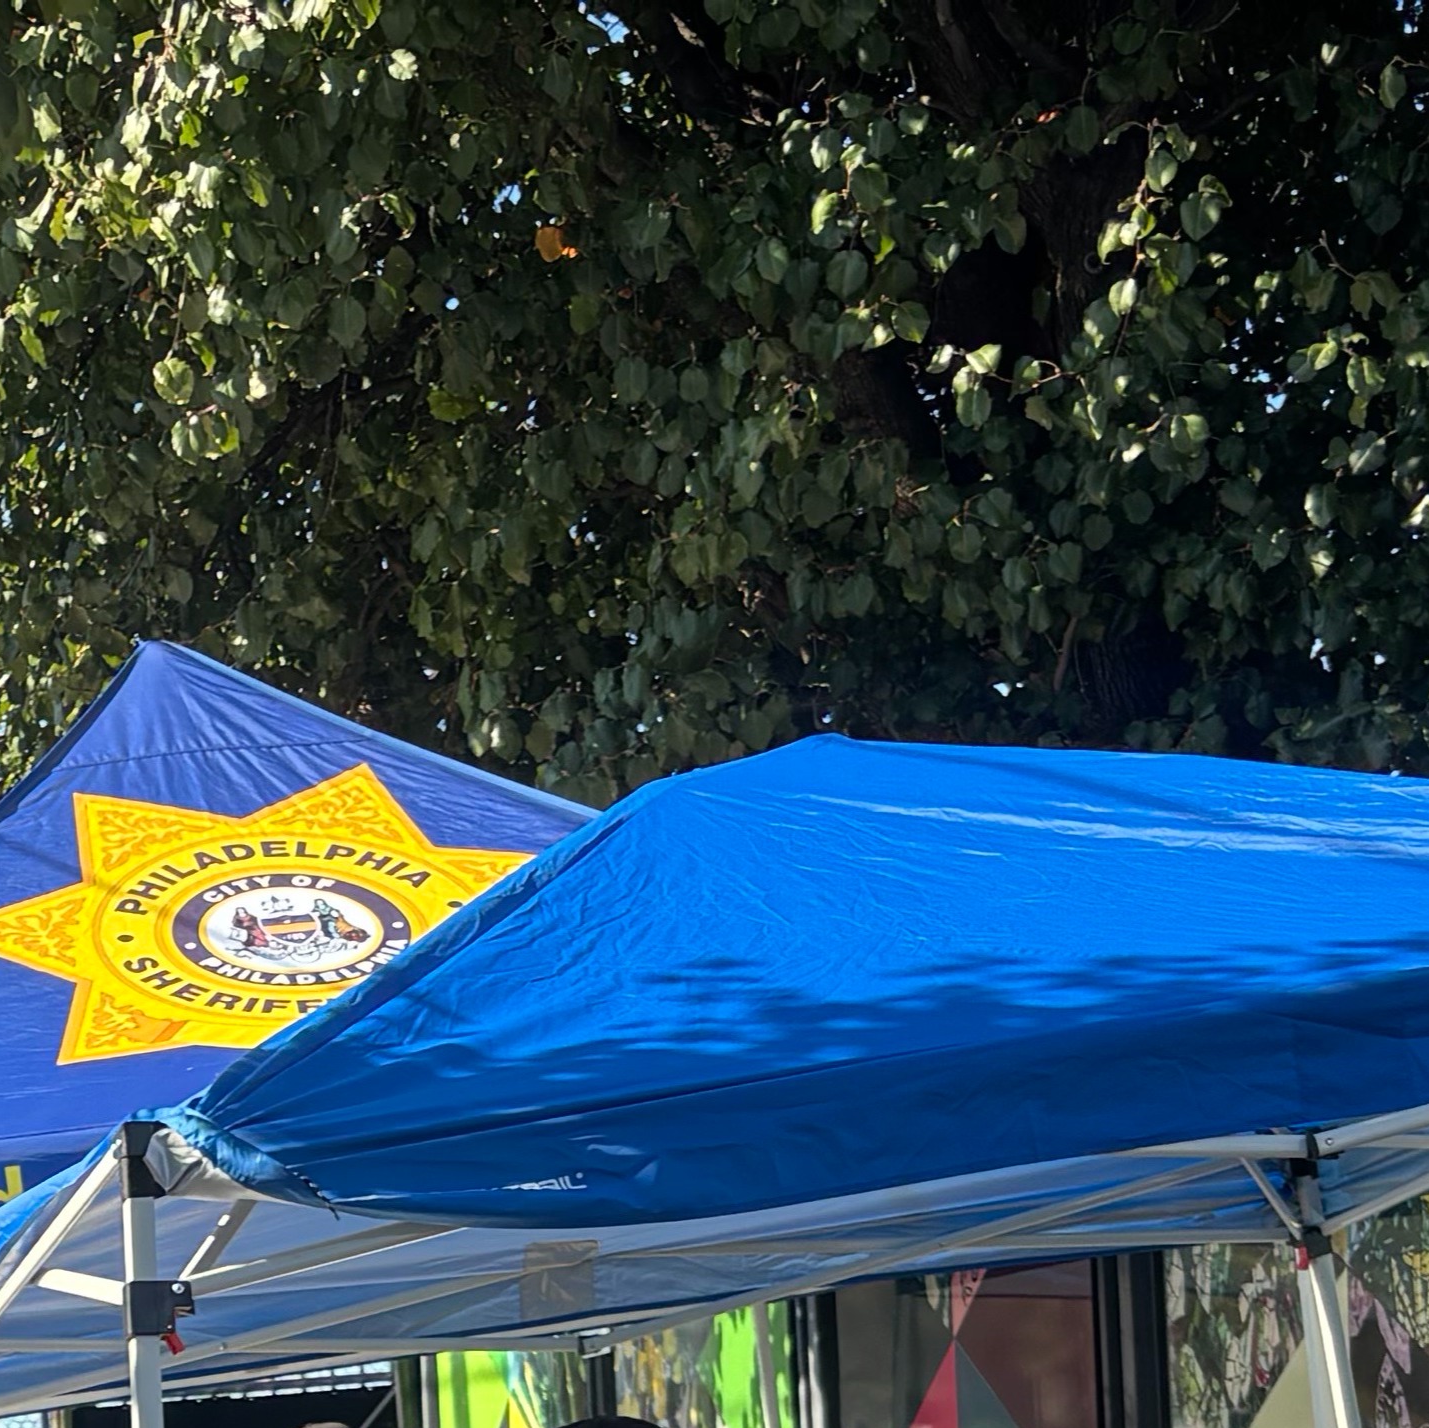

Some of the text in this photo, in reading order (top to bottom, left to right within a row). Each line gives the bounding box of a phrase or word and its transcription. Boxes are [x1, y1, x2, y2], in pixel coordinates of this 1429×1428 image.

[115, 840, 432, 916] PHILADELPHIA
[202, 874, 336, 904] CITY OF
[198, 938, 409, 986] PHILADELPHIA
